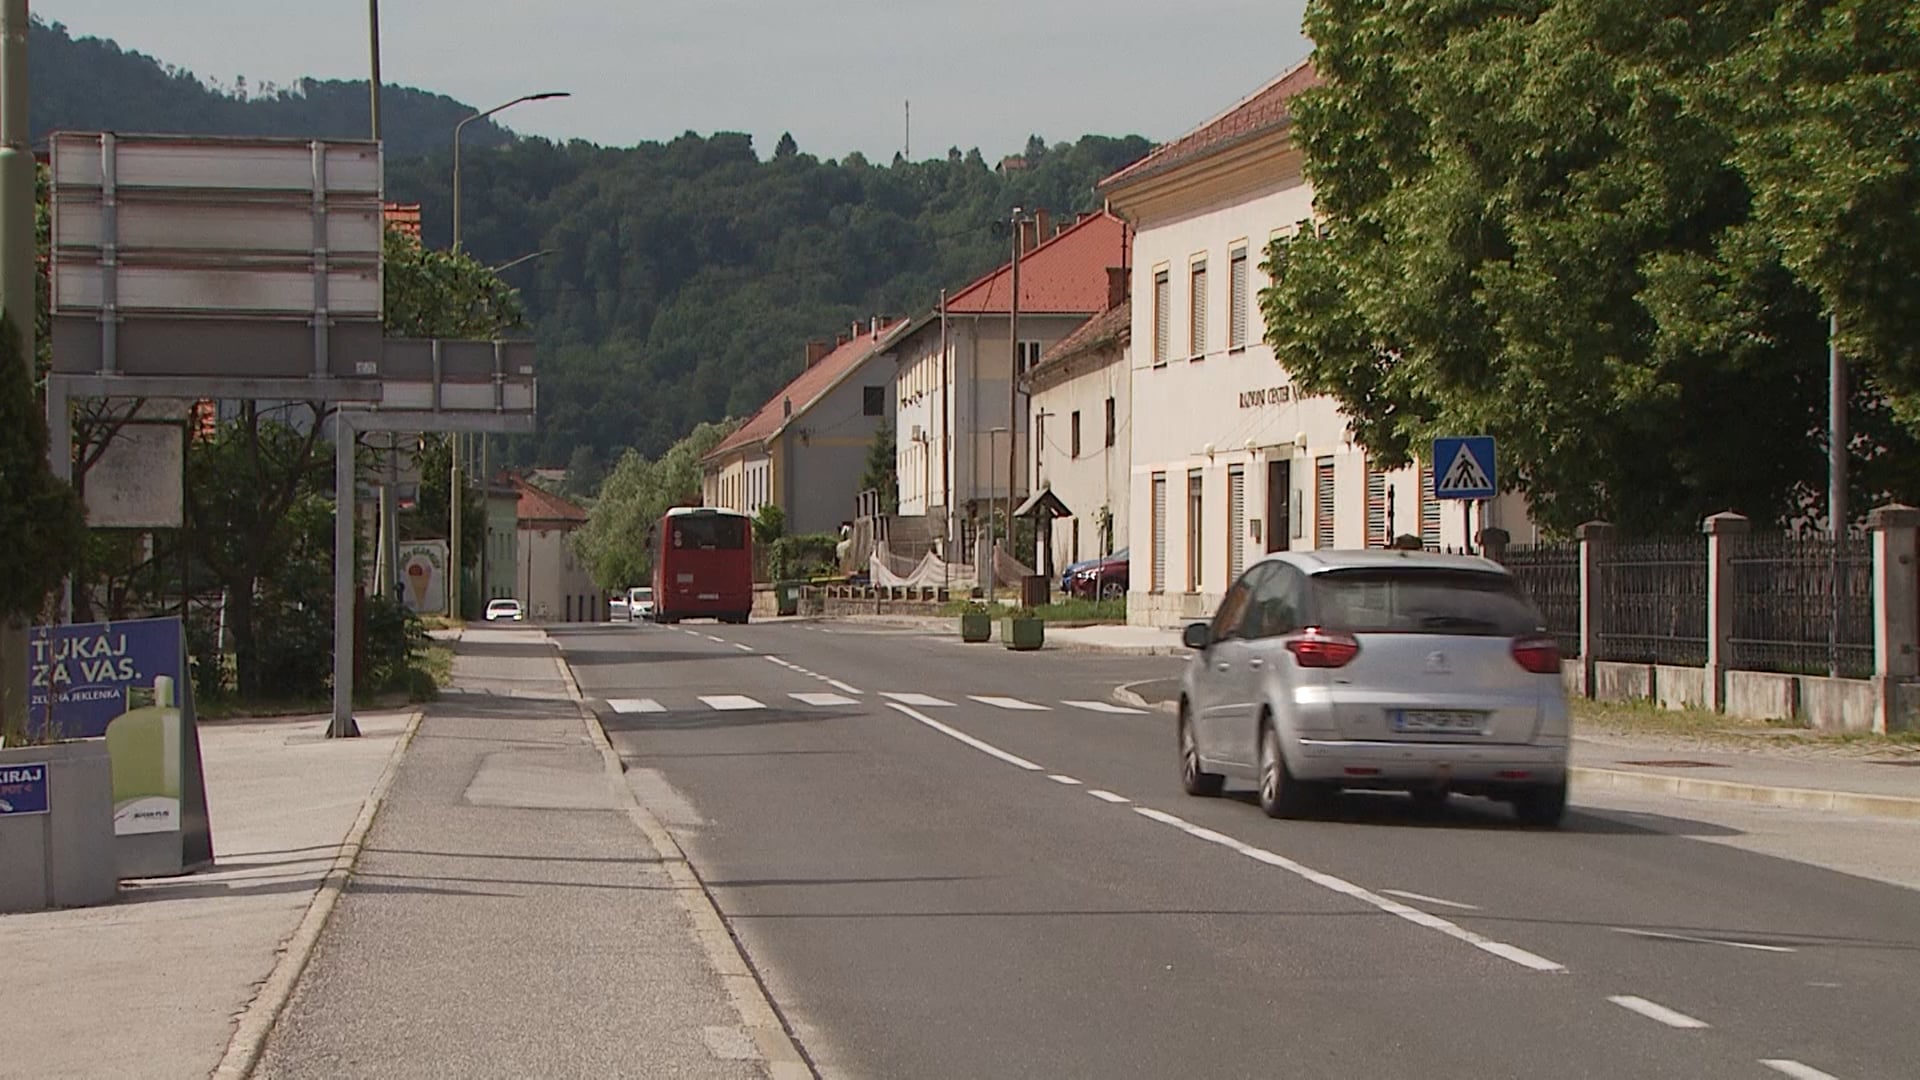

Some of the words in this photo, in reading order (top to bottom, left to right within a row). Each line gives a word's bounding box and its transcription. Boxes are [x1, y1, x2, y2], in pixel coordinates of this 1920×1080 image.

[32, 634, 127, 662] TUKAJ
[32, 663, 72, 686] ZA
[80, 657, 142, 683] VAS.
[32, 693, 70, 705] ZELNA
[71, 689, 121, 702] JEKLENKA
